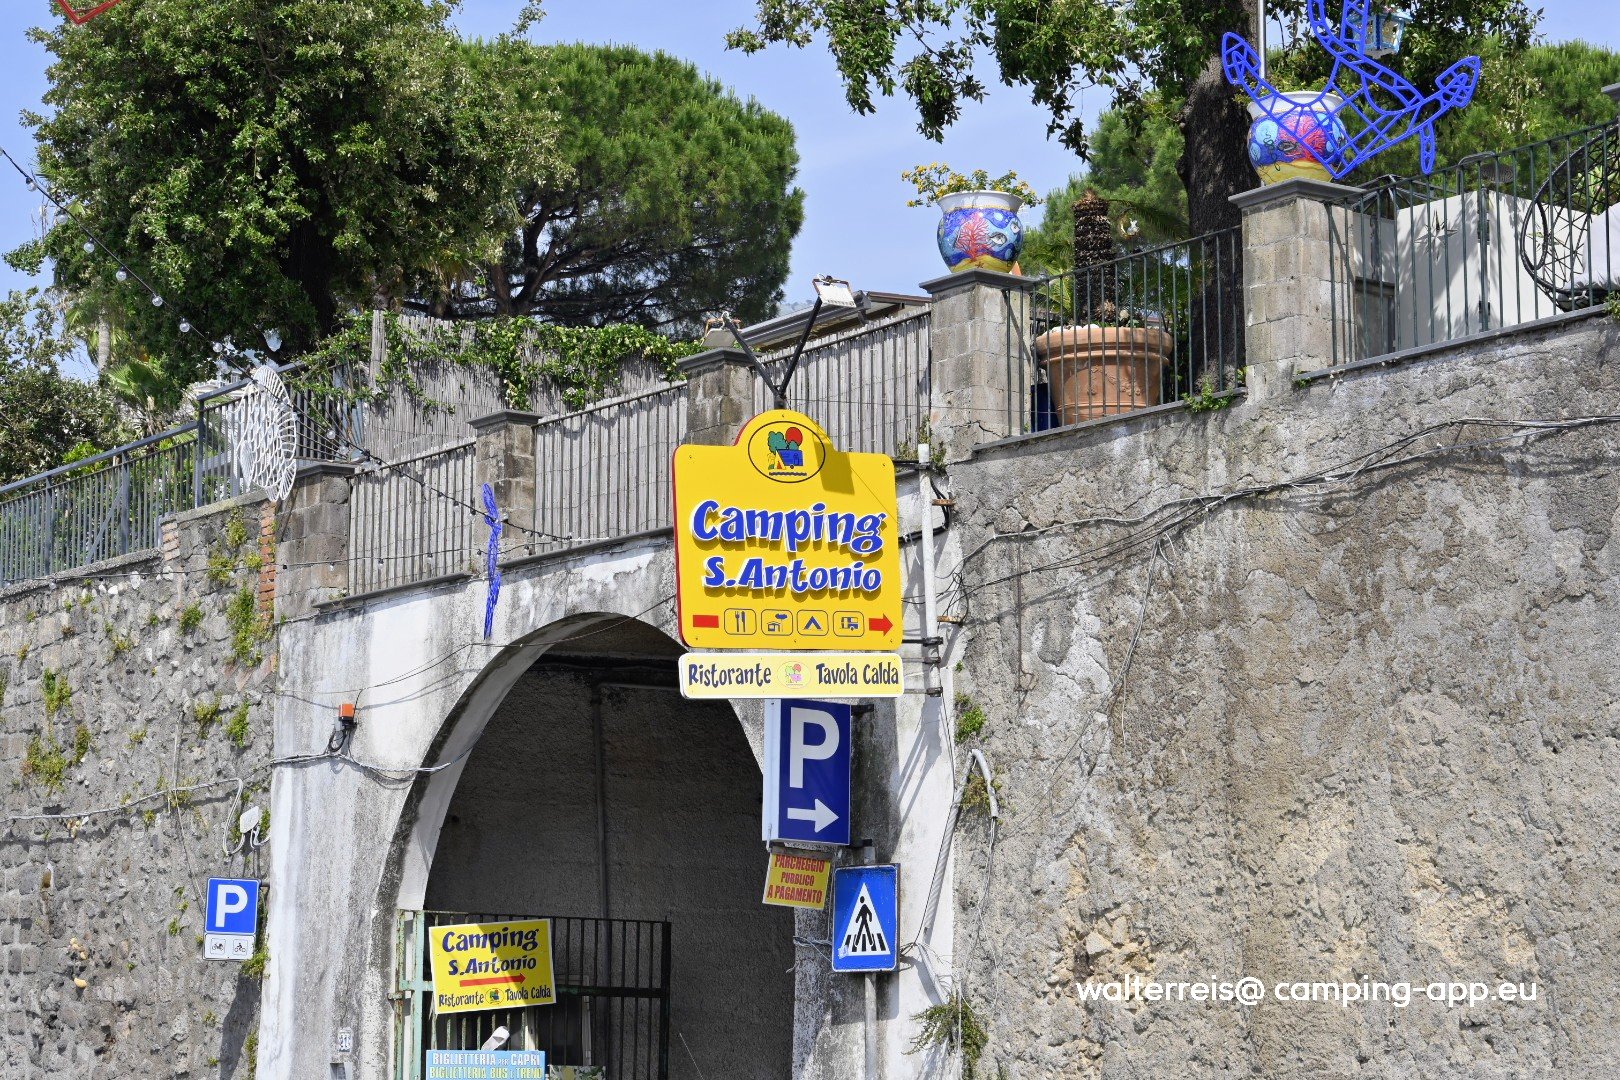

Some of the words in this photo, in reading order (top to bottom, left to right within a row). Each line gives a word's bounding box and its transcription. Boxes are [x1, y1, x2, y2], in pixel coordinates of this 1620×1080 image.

[690, 500, 887, 554] Camping
[703, 556, 882, 593] S.Antonio
[688, 663, 772, 688] Ristorante
[816, 662, 858, 685] Tavola
[863, 662, 899, 685] Calda
[789, 706, 840, 789] P
[774, 854, 825, 873] PARCHEGGIO
[780, 872, 815, 886] PUBBLICO
[767, 885, 774, 898] A
[774, 885, 823, 904] PAGAMENTO
[215, 884, 248, 928] P
[442, 927, 539, 954] Camping
[448, 955, 537, 976] S.Antonio
[438, 991, 484, 1008] Ristorante
[505, 986, 529, 1001] Tavola
[531, 985, 552, 999] Calda
[432, 1053, 496, 1066] BIGLIETTERIA
[511, 1053, 540, 1066] CAPRI
[429, 1067, 487, 1079] BIGLIETTERIA
[490, 1067, 508, 1079] BUS
[516, 1067, 542, 1079] TRENO
